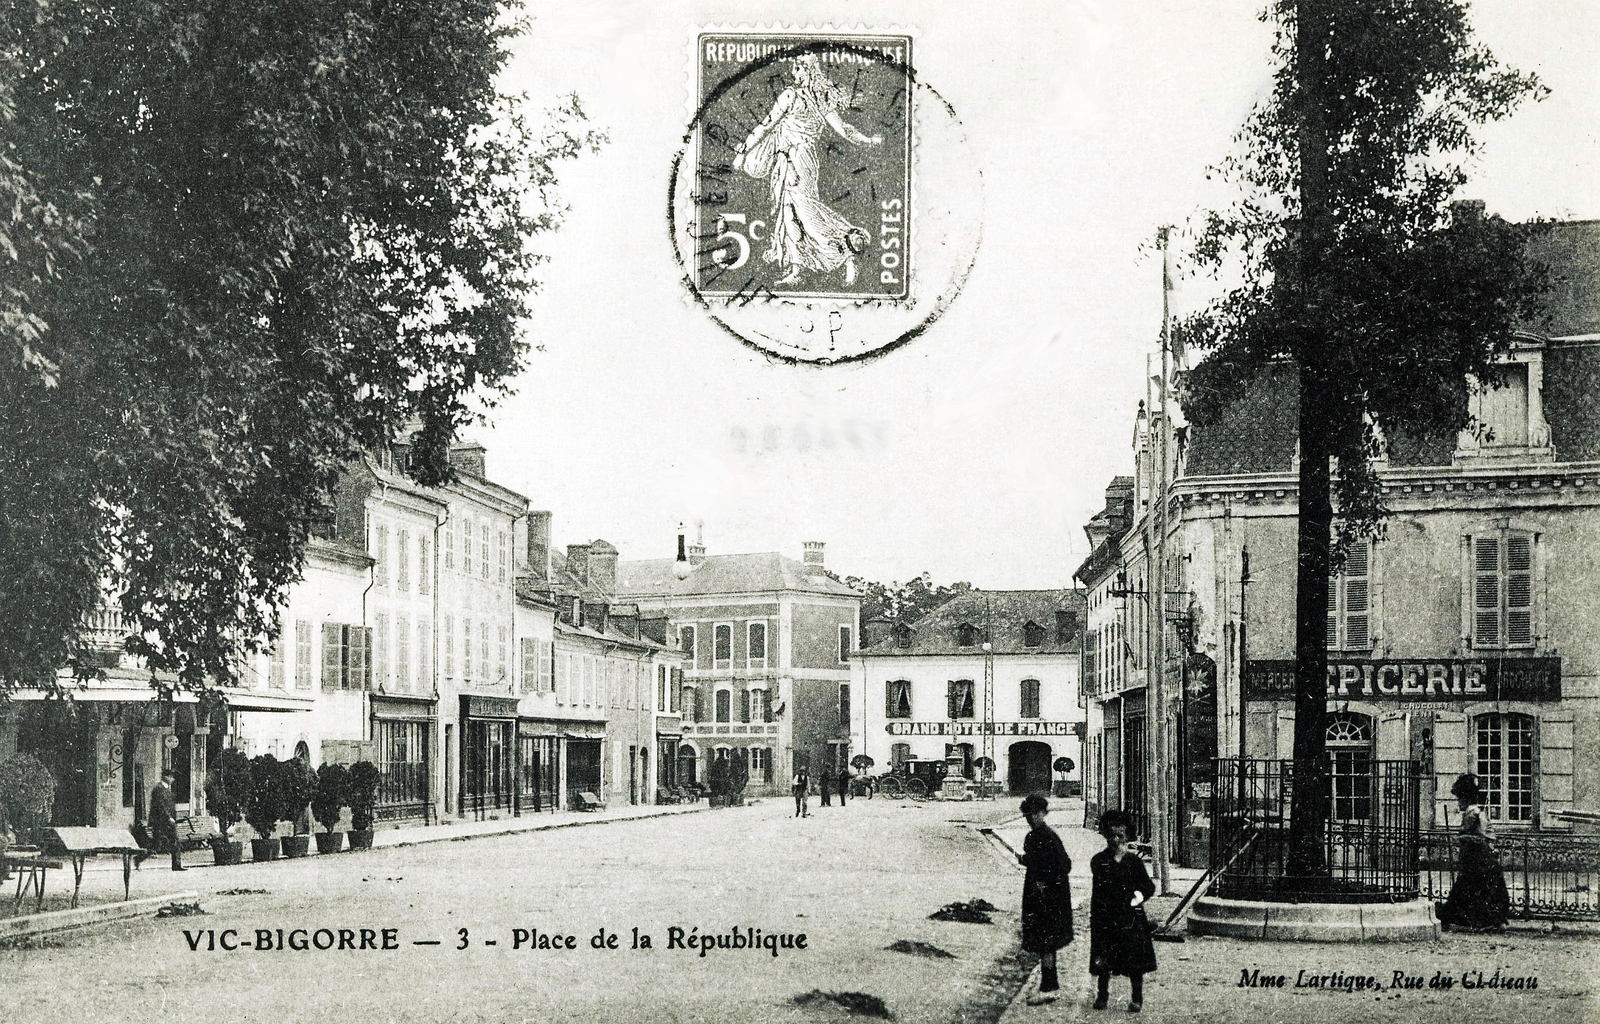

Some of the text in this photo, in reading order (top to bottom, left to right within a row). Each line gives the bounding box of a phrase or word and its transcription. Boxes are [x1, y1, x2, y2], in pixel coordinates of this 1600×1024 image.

[880, 198, 901, 284] POSTES
[1403, 702, 1450, 710] CHOCOLAT
[892, 723, 939, 735] GRAND
[994, 723, 1014, 735] DE
[1017, 723, 1077, 735] FRANCE
